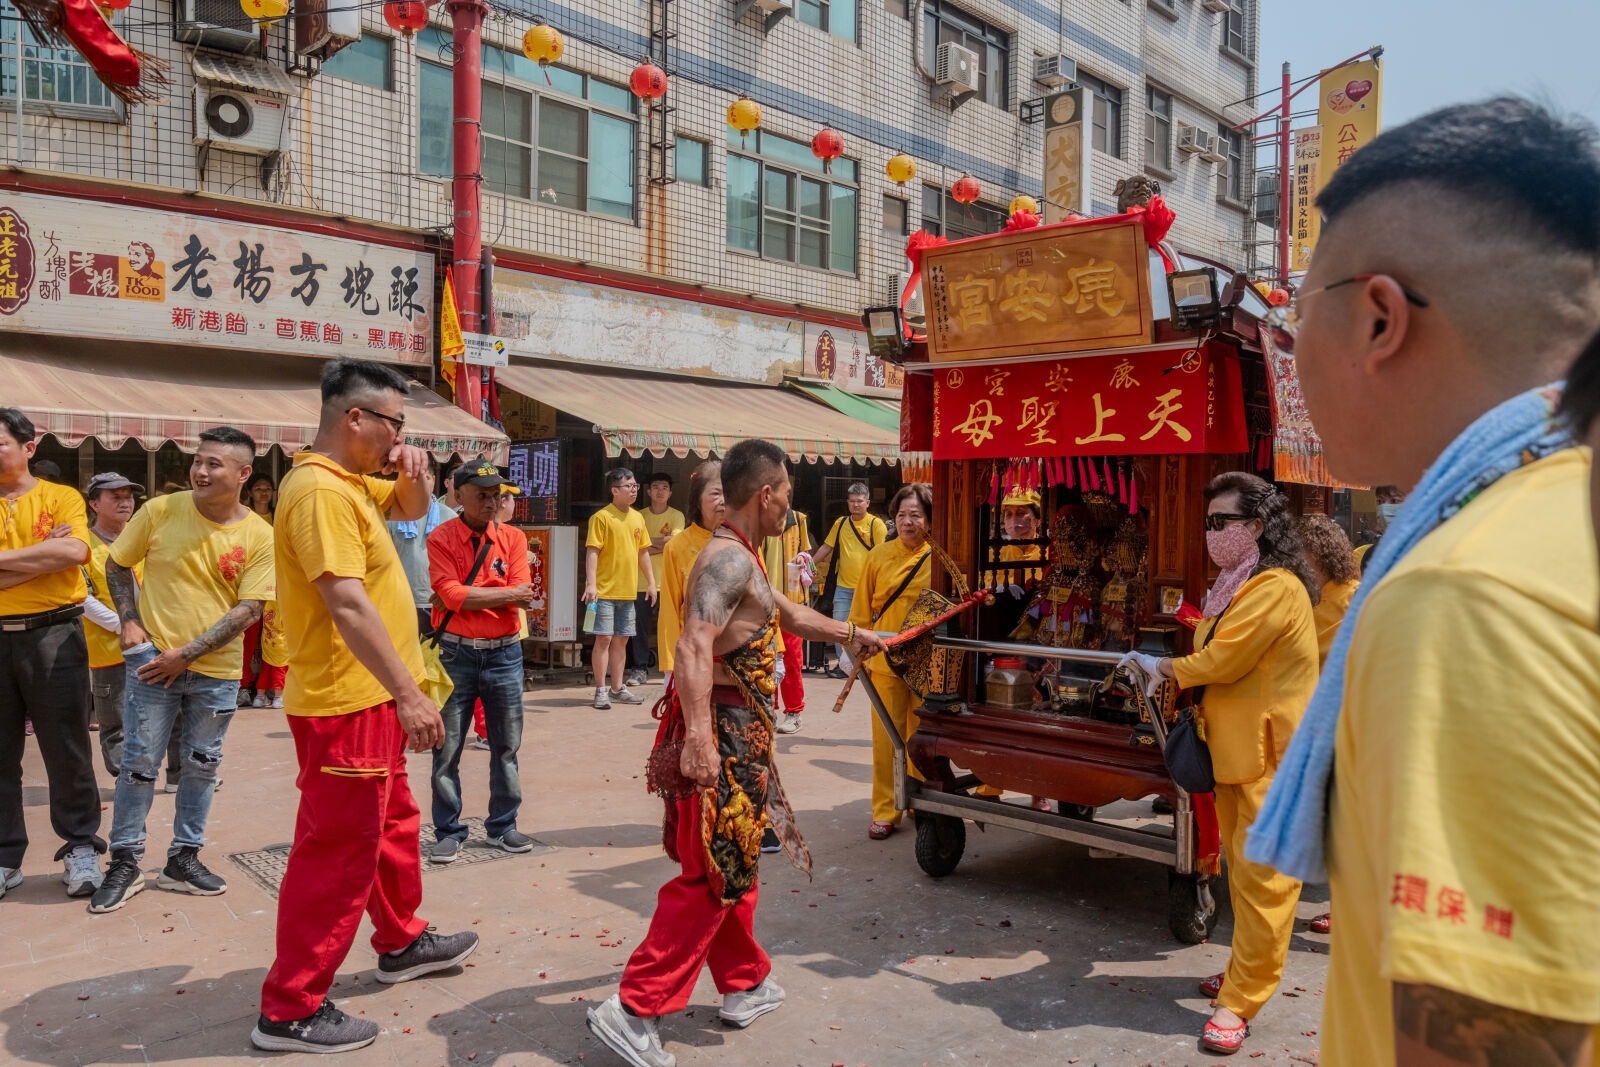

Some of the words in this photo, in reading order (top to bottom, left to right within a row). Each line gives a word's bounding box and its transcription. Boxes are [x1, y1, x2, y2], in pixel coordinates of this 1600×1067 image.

[1298, 164, 1308, 239] 國際媽祖文化節
[125, 277, 144, 286] TK
[126, 285, 160, 296] FOOD
[171, 233, 426, 321] 老楊方塊酥
[949, 370, 962, 386] 山
[951, 388, 1192, 447] 天上聖母
